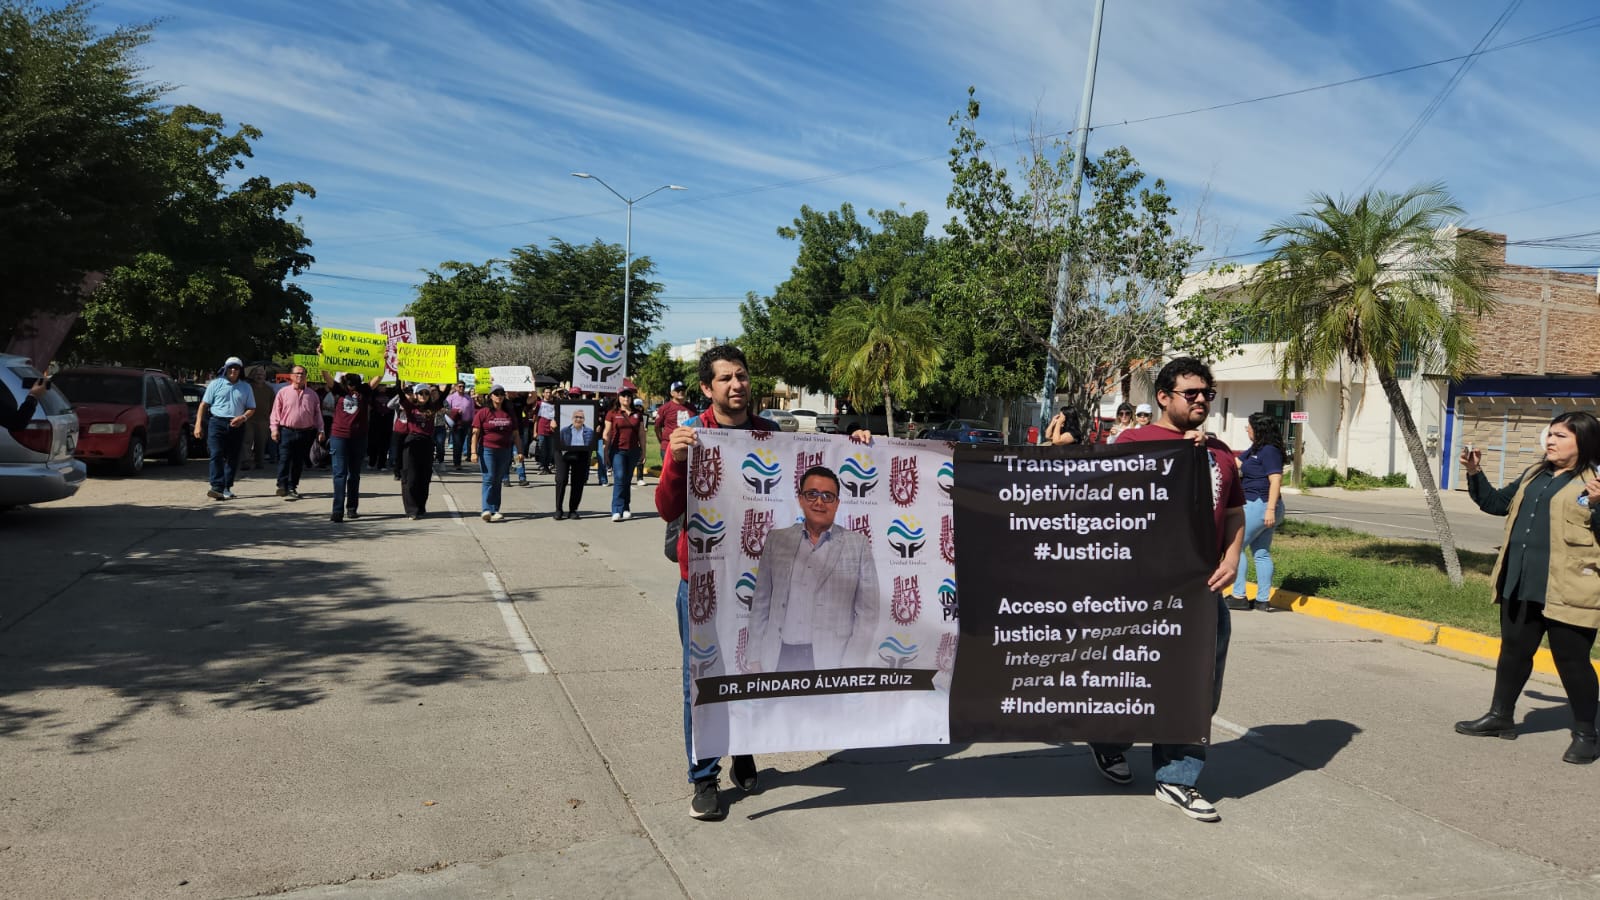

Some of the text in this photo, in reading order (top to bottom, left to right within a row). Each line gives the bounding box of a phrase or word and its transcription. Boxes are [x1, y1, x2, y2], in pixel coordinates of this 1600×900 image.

[805, 451, 823, 468] IPN
[899, 455, 917, 472] IPN
[993, 455, 1174, 476] "Transparencia y
[999, 483, 1169, 505] objetividad en la
[1009, 512, 1156, 535] investigacion"
[1034, 542, 1132, 561] #Justicia
[998, 595, 1183, 615] Acceso efectivo a la
[993, 619, 1182, 646] justicia y reparación
[1005, 645, 1161, 667] integral del daño
[719, 672, 913, 696] DR. PÍNDARO ÁLVAREZ RÚIZ
[1012, 670, 1152, 691] para la familia.
[1000, 697, 1155, 715] #Indemnización
